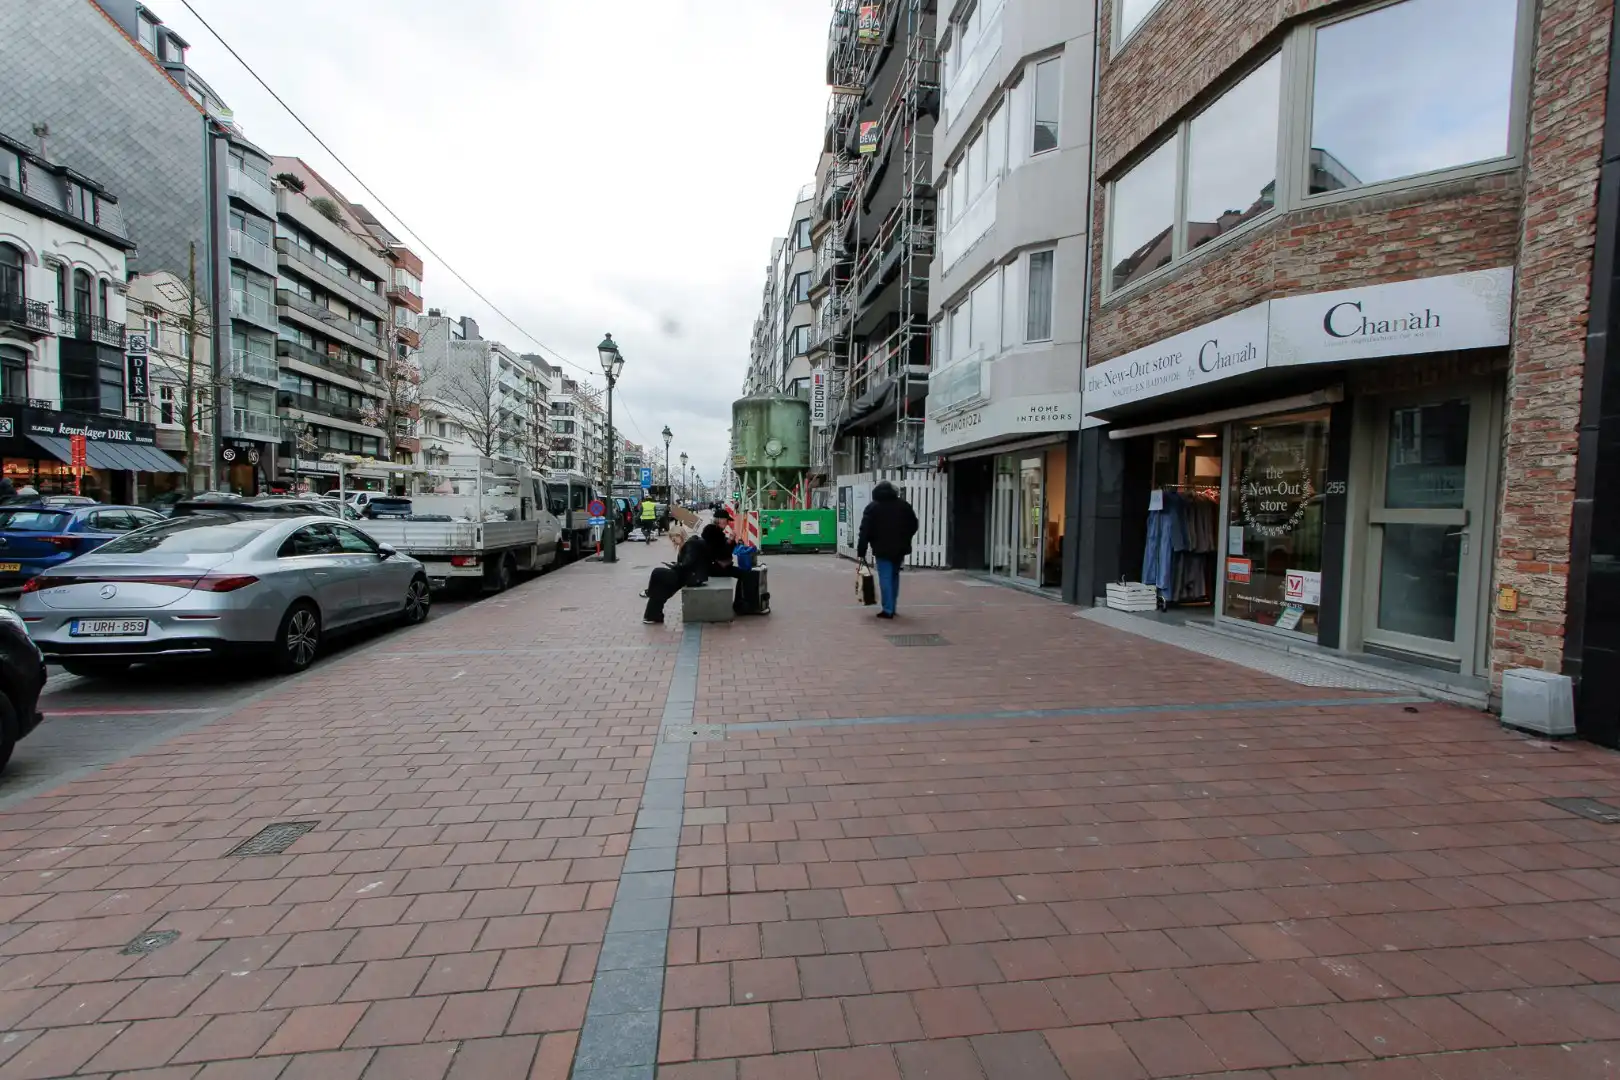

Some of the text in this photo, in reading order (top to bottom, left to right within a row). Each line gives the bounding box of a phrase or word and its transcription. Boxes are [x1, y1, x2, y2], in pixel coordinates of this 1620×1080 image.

[1323, 301, 1441, 338] Chanàh
[134, 358, 145, 394] DIRK
[1088, 378, 1101, 392] the
[1104, 361, 1150, 387] New-Out
[1153, 351, 1183, 372] store
[814, 384, 825, 418] STEICON
[1030, 405, 1059, 413] HOME
[1016, 413, 1073, 423] INTERIORS
[59, 422, 132, 441] keurslager DIRK
[641, 470, 650, 480] P
[1266, 465, 1284, 479] the
[1248, 481, 1301, 496] New-Out
[1326, 481, 1346, 494] 255
[1259, 500, 1288, 512] store
